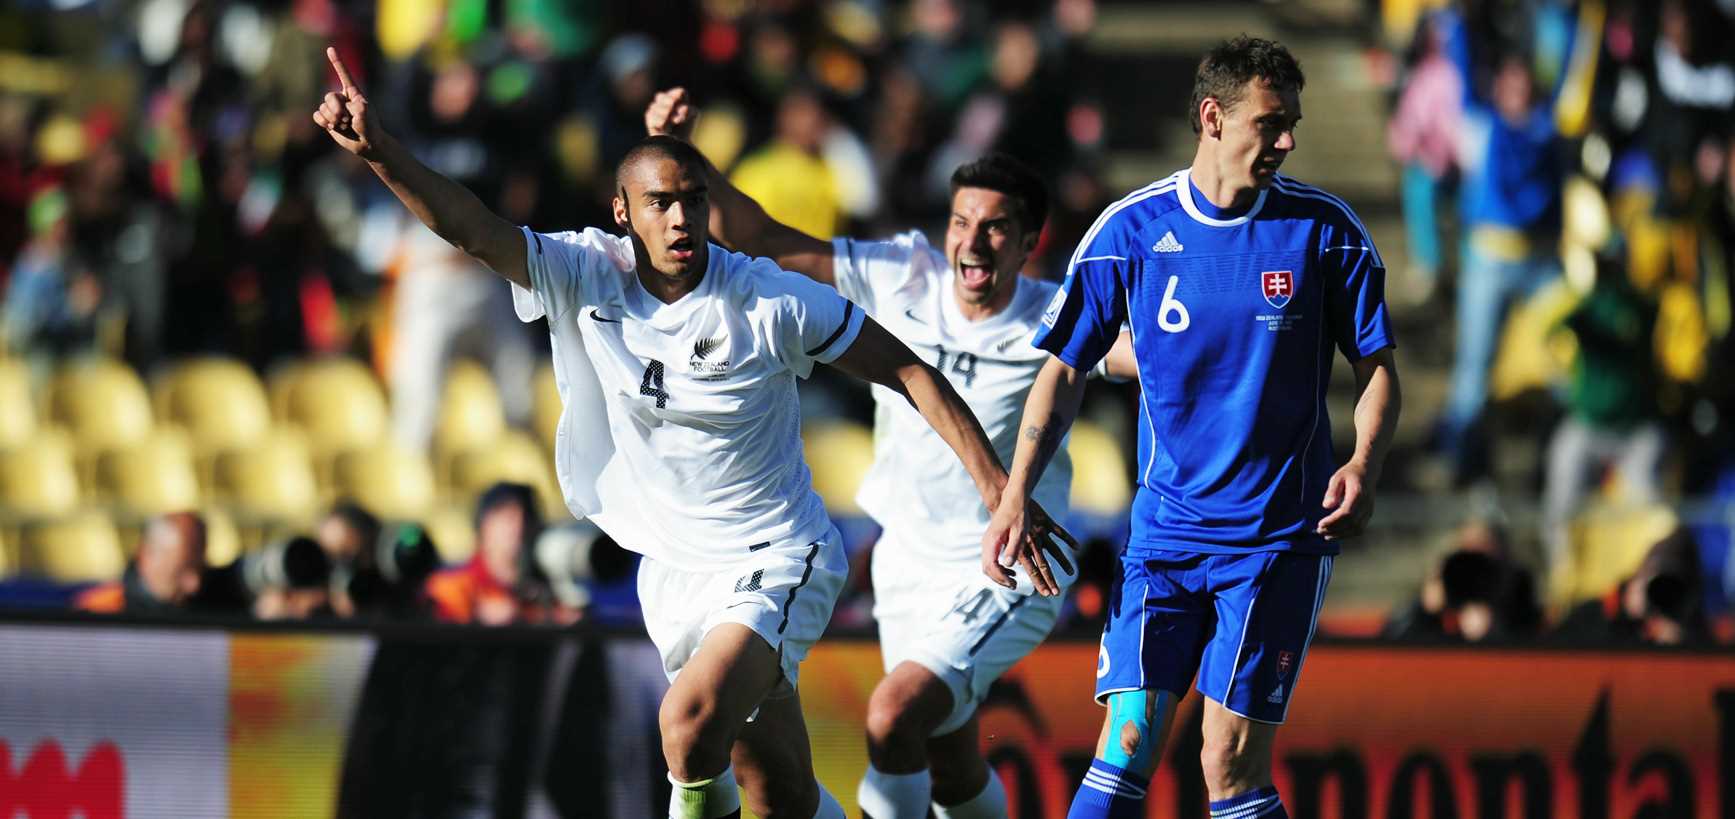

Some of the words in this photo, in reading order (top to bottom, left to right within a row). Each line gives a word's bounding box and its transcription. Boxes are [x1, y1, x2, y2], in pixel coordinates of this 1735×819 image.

[1157, 275, 1191, 334] 6
[639, 358, 671, 410] 4
[935, 343, 978, 389] 14
